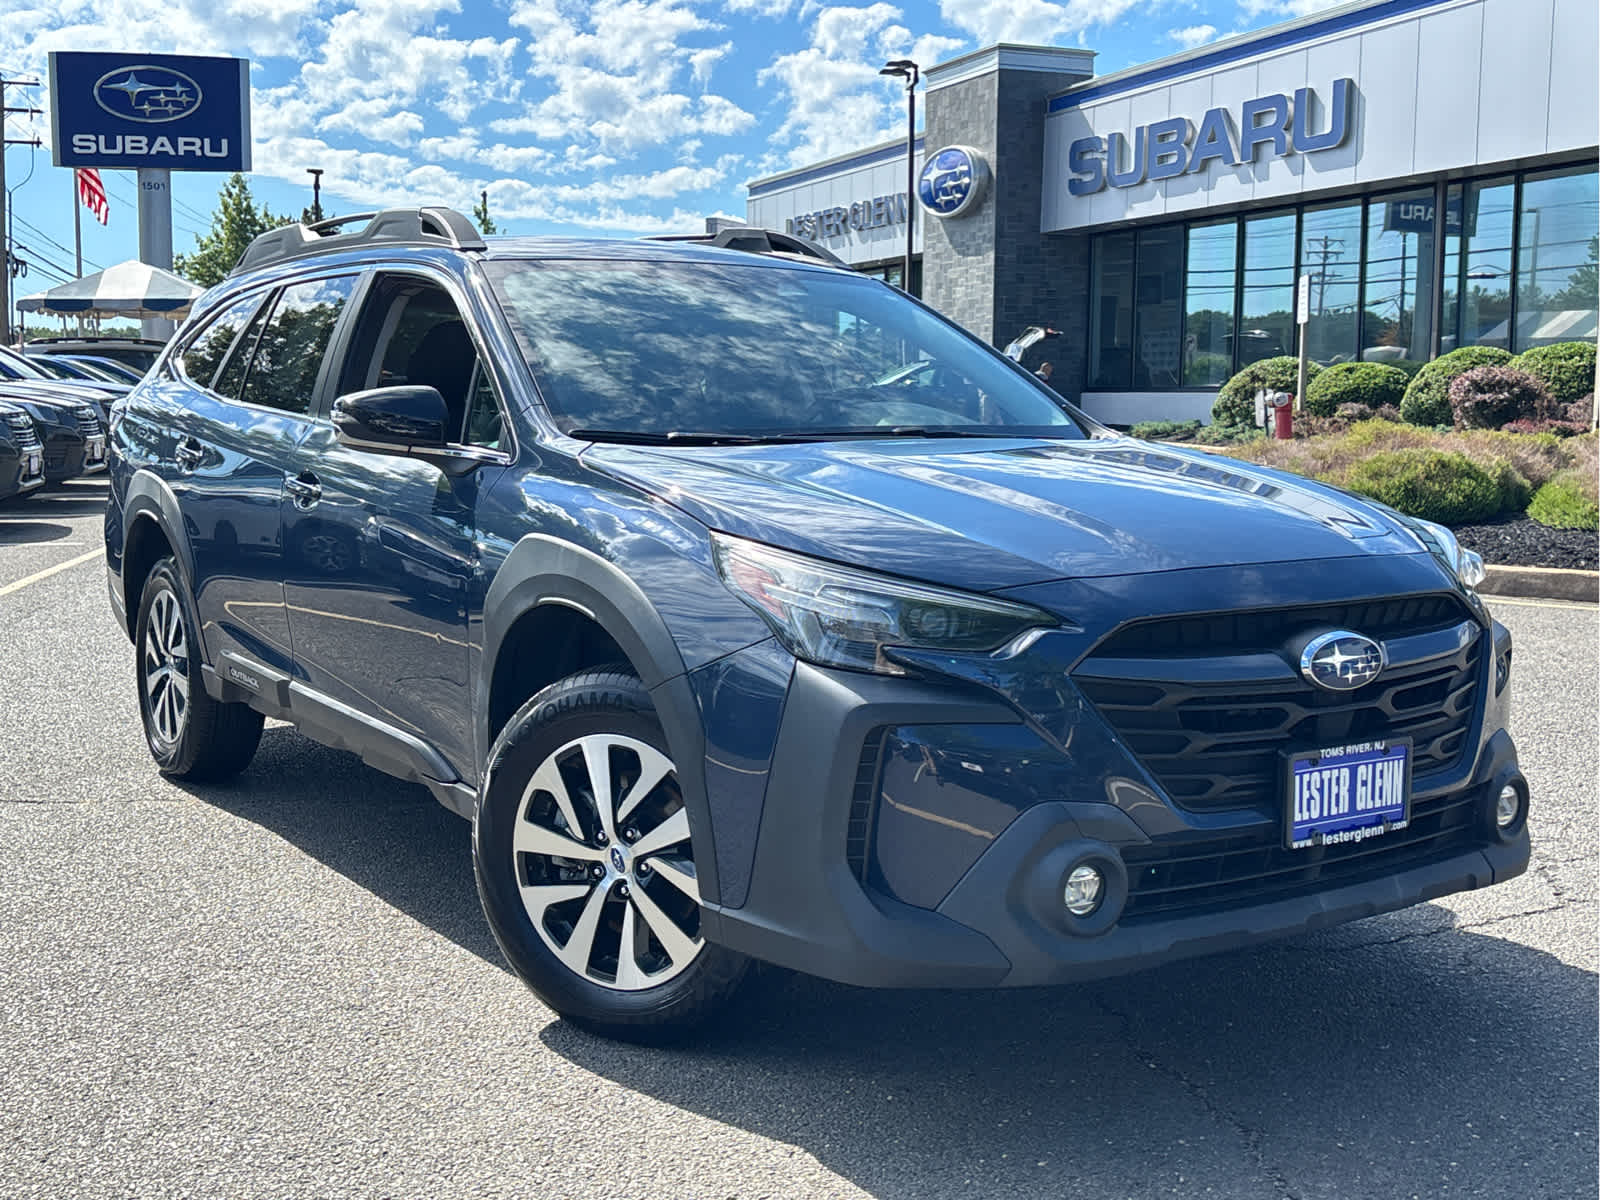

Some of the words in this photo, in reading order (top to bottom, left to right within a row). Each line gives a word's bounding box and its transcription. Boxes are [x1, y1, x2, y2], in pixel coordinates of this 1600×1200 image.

[72, 133, 228, 157] SUBARU
[1069, 78, 1352, 195] SUBARU
[143, 181, 165, 190] 1501
[786, 207, 848, 241] LESTER
[849, 192, 908, 231] GLENN
[1320, 748, 1344, 758] TOMS
[1374, 741, 1385, 750] NJ
[1294, 767, 1350, 822] LESTER
[1356, 759, 1404, 811] GLENN
